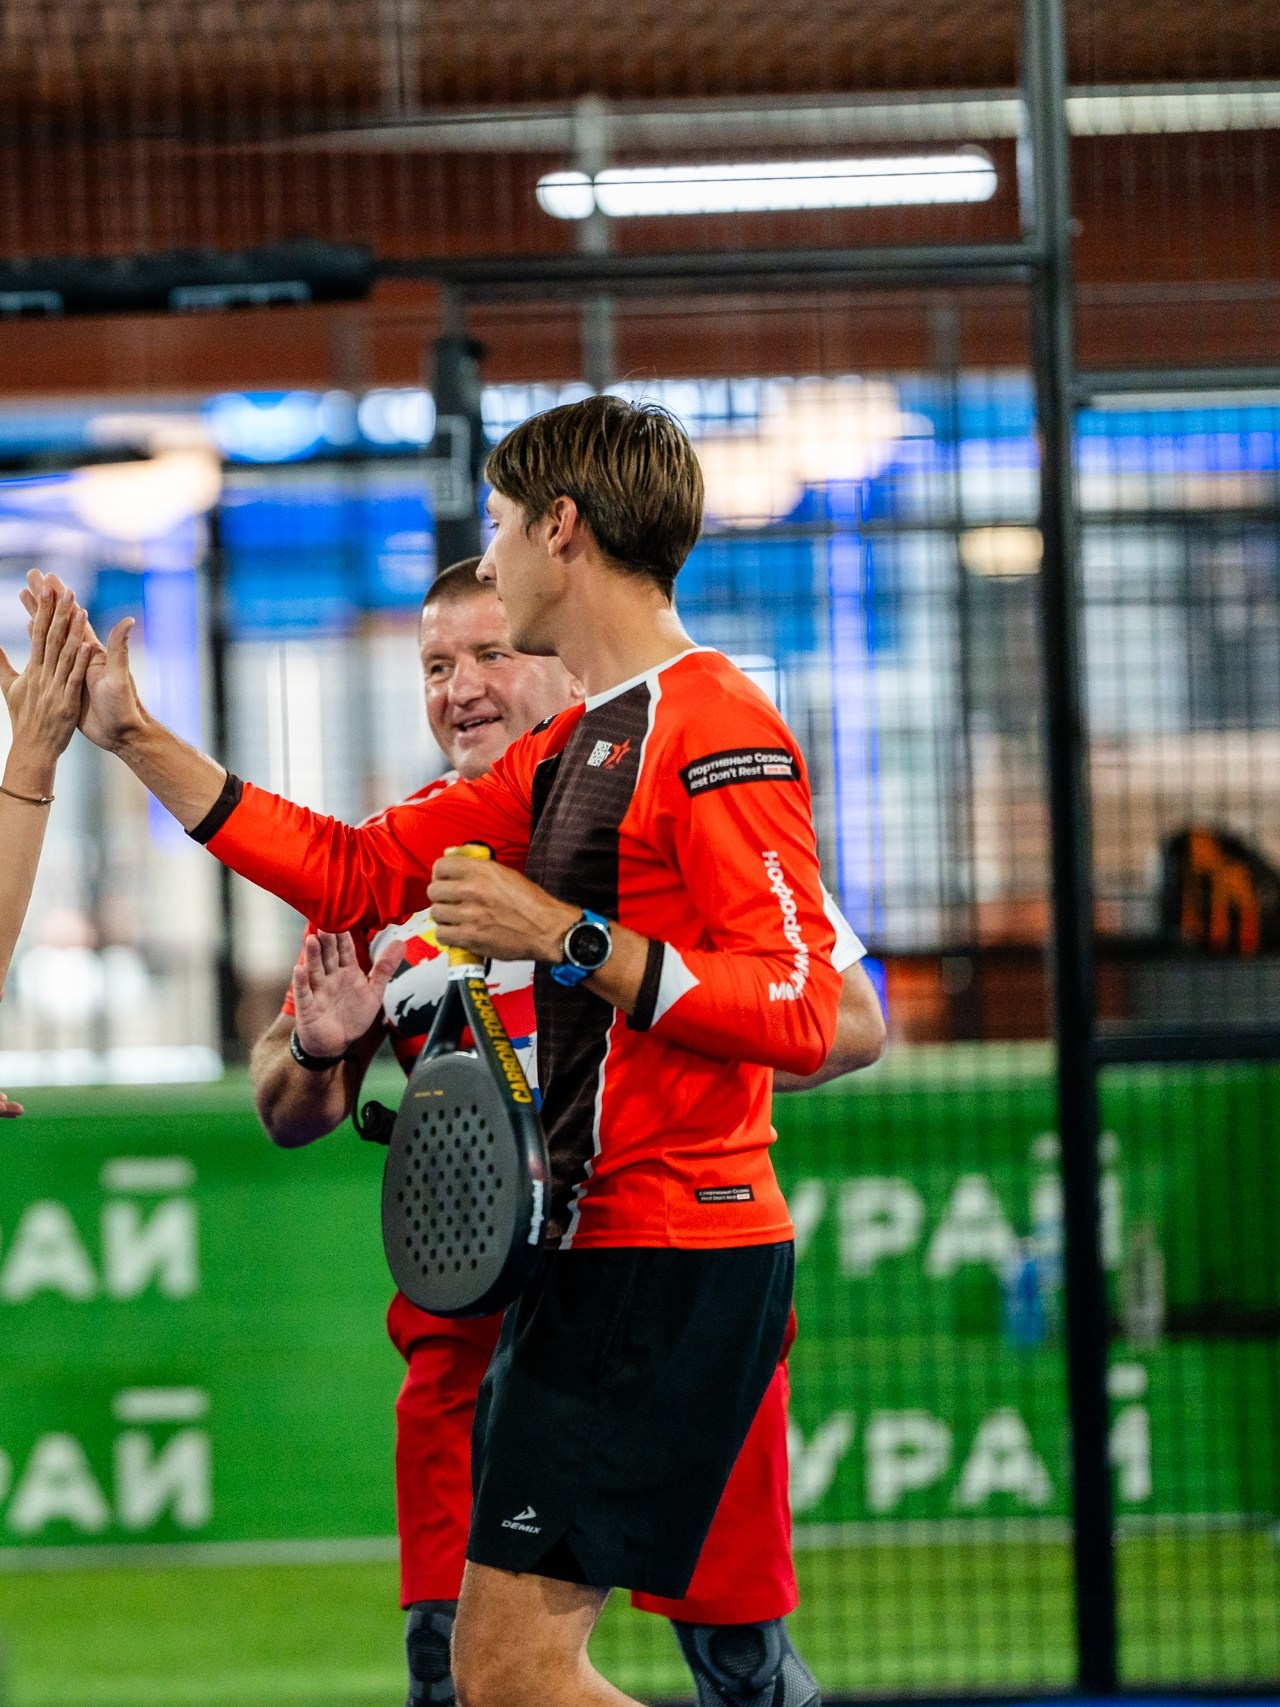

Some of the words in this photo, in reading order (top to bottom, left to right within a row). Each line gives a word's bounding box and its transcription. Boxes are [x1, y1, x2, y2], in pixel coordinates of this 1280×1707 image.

[687, 754, 753, 780] портивные
[690, 776, 708, 790] est
[709, 768, 737, 784] Don't
[739, 765, 762, 776] Rest
[471, 991, 507, 1038] FORCE
[492, 1040, 533, 1103] CARBON
